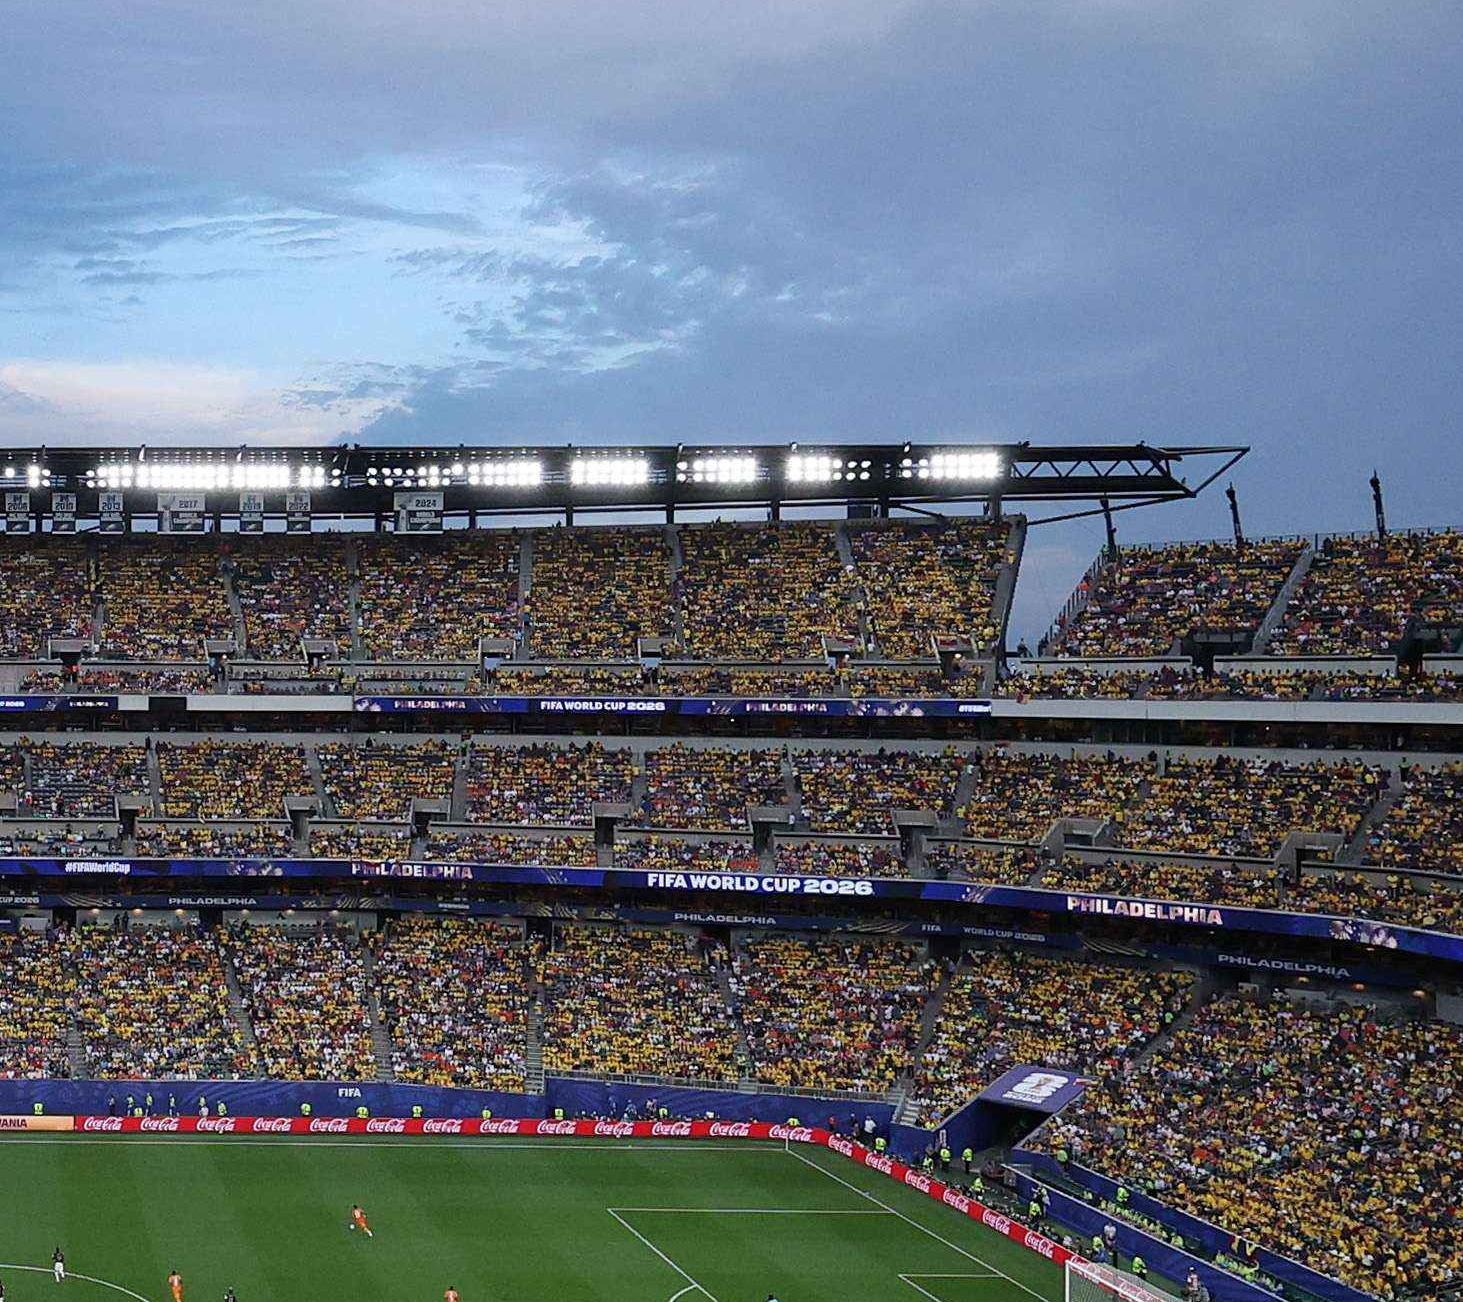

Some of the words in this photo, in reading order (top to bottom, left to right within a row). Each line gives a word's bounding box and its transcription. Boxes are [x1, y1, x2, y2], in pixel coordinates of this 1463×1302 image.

[540, 701, 562, 710] FIFA
[563, 701, 601, 710] WORLD
[603, 701, 625, 711] CUP
[627, 702, 666, 711] 2026
[352, 863, 473, 880] PHILADELPHIA
[648, 873, 686, 888] FIFA
[690, 875, 758, 891] WORLD
[762, 877, 800, 893] CUP
[804, 879, 874, 896] 2026
[674, 912, 777, 925] PHILADELPHIA
[1067, 896, 1223, 925] PHILADELPHIA
[1217, 953, 1351, 978] PHILADELPHIA
[338, 1087, 362, 1097] FIFA
